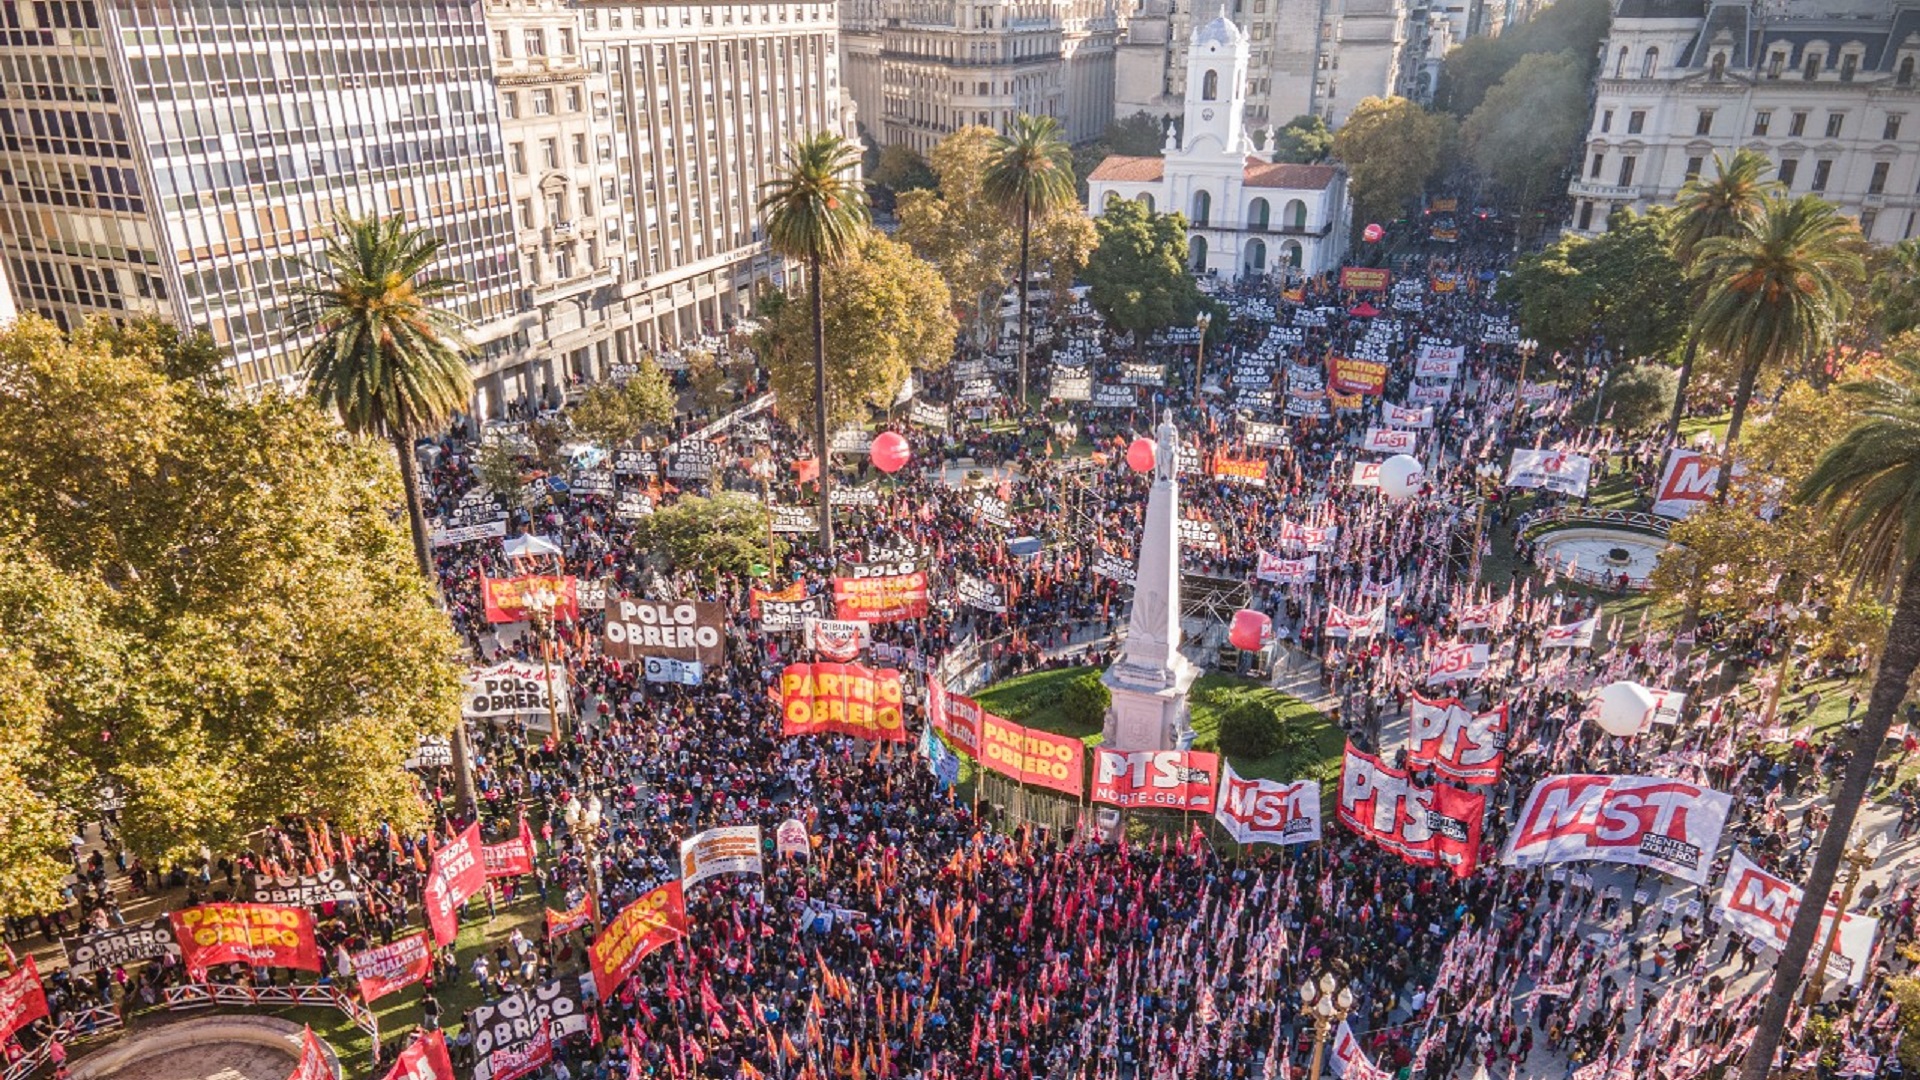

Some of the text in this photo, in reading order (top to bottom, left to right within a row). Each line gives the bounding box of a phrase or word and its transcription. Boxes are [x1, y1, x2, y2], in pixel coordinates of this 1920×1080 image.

[1420, 336, 1452, 345] POLO
[1238, 368, 1266, 376] POLO
[1336, 360, 1386, 374] PARTIDO
[1338, 370, 1383, 385] OBRERO
[1422, 362, 1450, 372] MST
[1102, 386, 1131, 395] POLO
[1232, 376, 1270, 384] OBRERO
[1239, 389, 1273, 398] POLO
[1292, 397, 1322, 407] POLO
[1391, 408, 1422, 422] MST
[836, 431, 868, 440] POLO
[1252, 425, 1286, 436] POLO
[1374, 430, 1408, 447] MST
[680, 440, 714, 452] POLO
[620, 452, 652, 462] POLO
[854, 562, 915, 578] POLO
[620, 602, 696, 626] POLO
[762, 600, 816, 613] POLO
[606, 621, 718, 648] OBRERO
[1430, 645, 1474, 677] MST
[485, 678, 540, 694] POLO
[784, 674, 901, 703] PARTIDO
[472, 694, 561, 712] OBRERO
[787, 702, 900, 730] OBRERO
[984, 721, 1074, 762] PARTIDO
[1411, 697, 1501, 765] PTS
[986, 743, 1069, 780] OBRERO
[1100, 751, 1182, 788] PTS
[1096, 788, 1186, 808] NORTE-GBA
[1342, 750, 1435, 842] PTS
[1230, 781, 1303, 835] MST
[1523, 779, 1700, 845] MST
[1643, 832, 1682, 852] FRENTE
[1640, 840, 1699, 866] IZQUIERDA
[255, 880, 346, 903] OBRERO
[182, 907, 299, 929] PARTIDO
[596, 890, 668, 962] PARTIDO
[76, 928, 171, 962] OBRERO
[195, 926, 299, 948] OBRERO
[353, 936, 424, 968] IZQUIERDA
[356, 946, 428, 981] SOCIALISTA
[477, 996, 574, 1055] OBRERO
